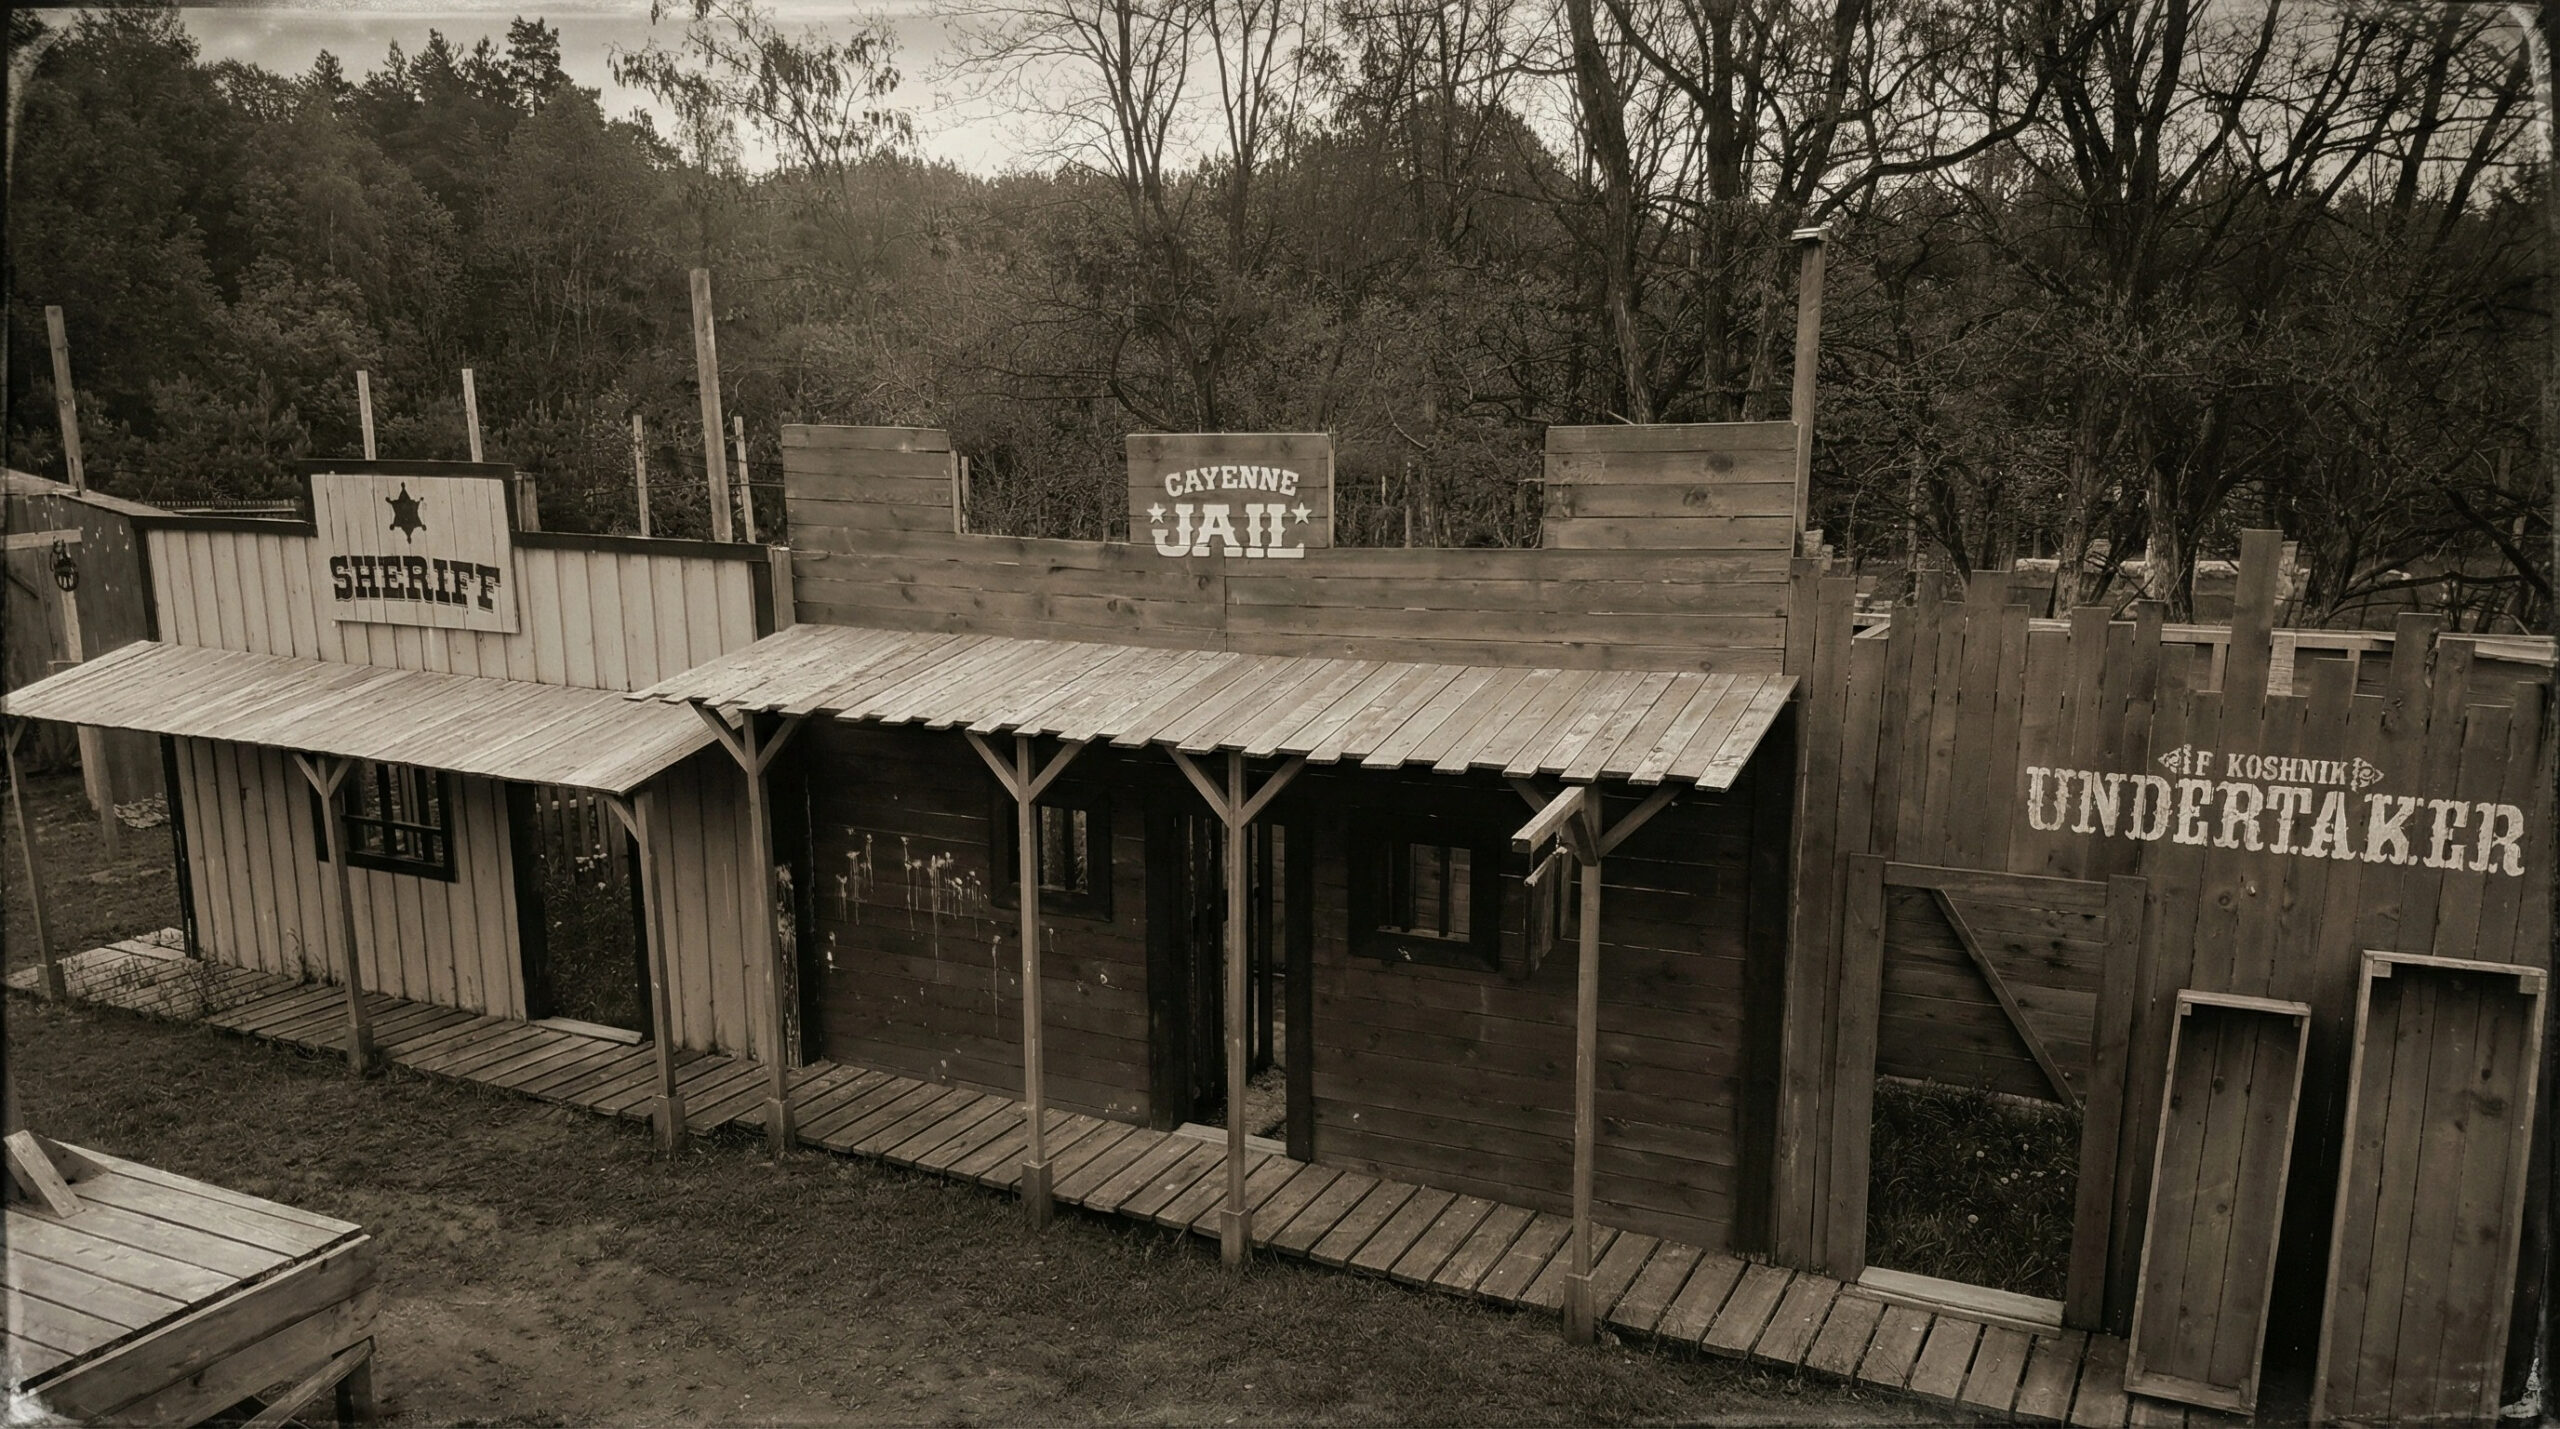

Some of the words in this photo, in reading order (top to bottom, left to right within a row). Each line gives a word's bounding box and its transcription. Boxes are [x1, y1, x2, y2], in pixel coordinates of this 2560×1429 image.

[1165, 465, 1299, 497] CAYENNE
[1151, 503, 1305, 559] JAIL
[329, 555, 501, 613] SHERIFF
[2226, 753, 2349, 785] KOSHNIK
[2026, 766, 2525, 877] UNDERTAKER
